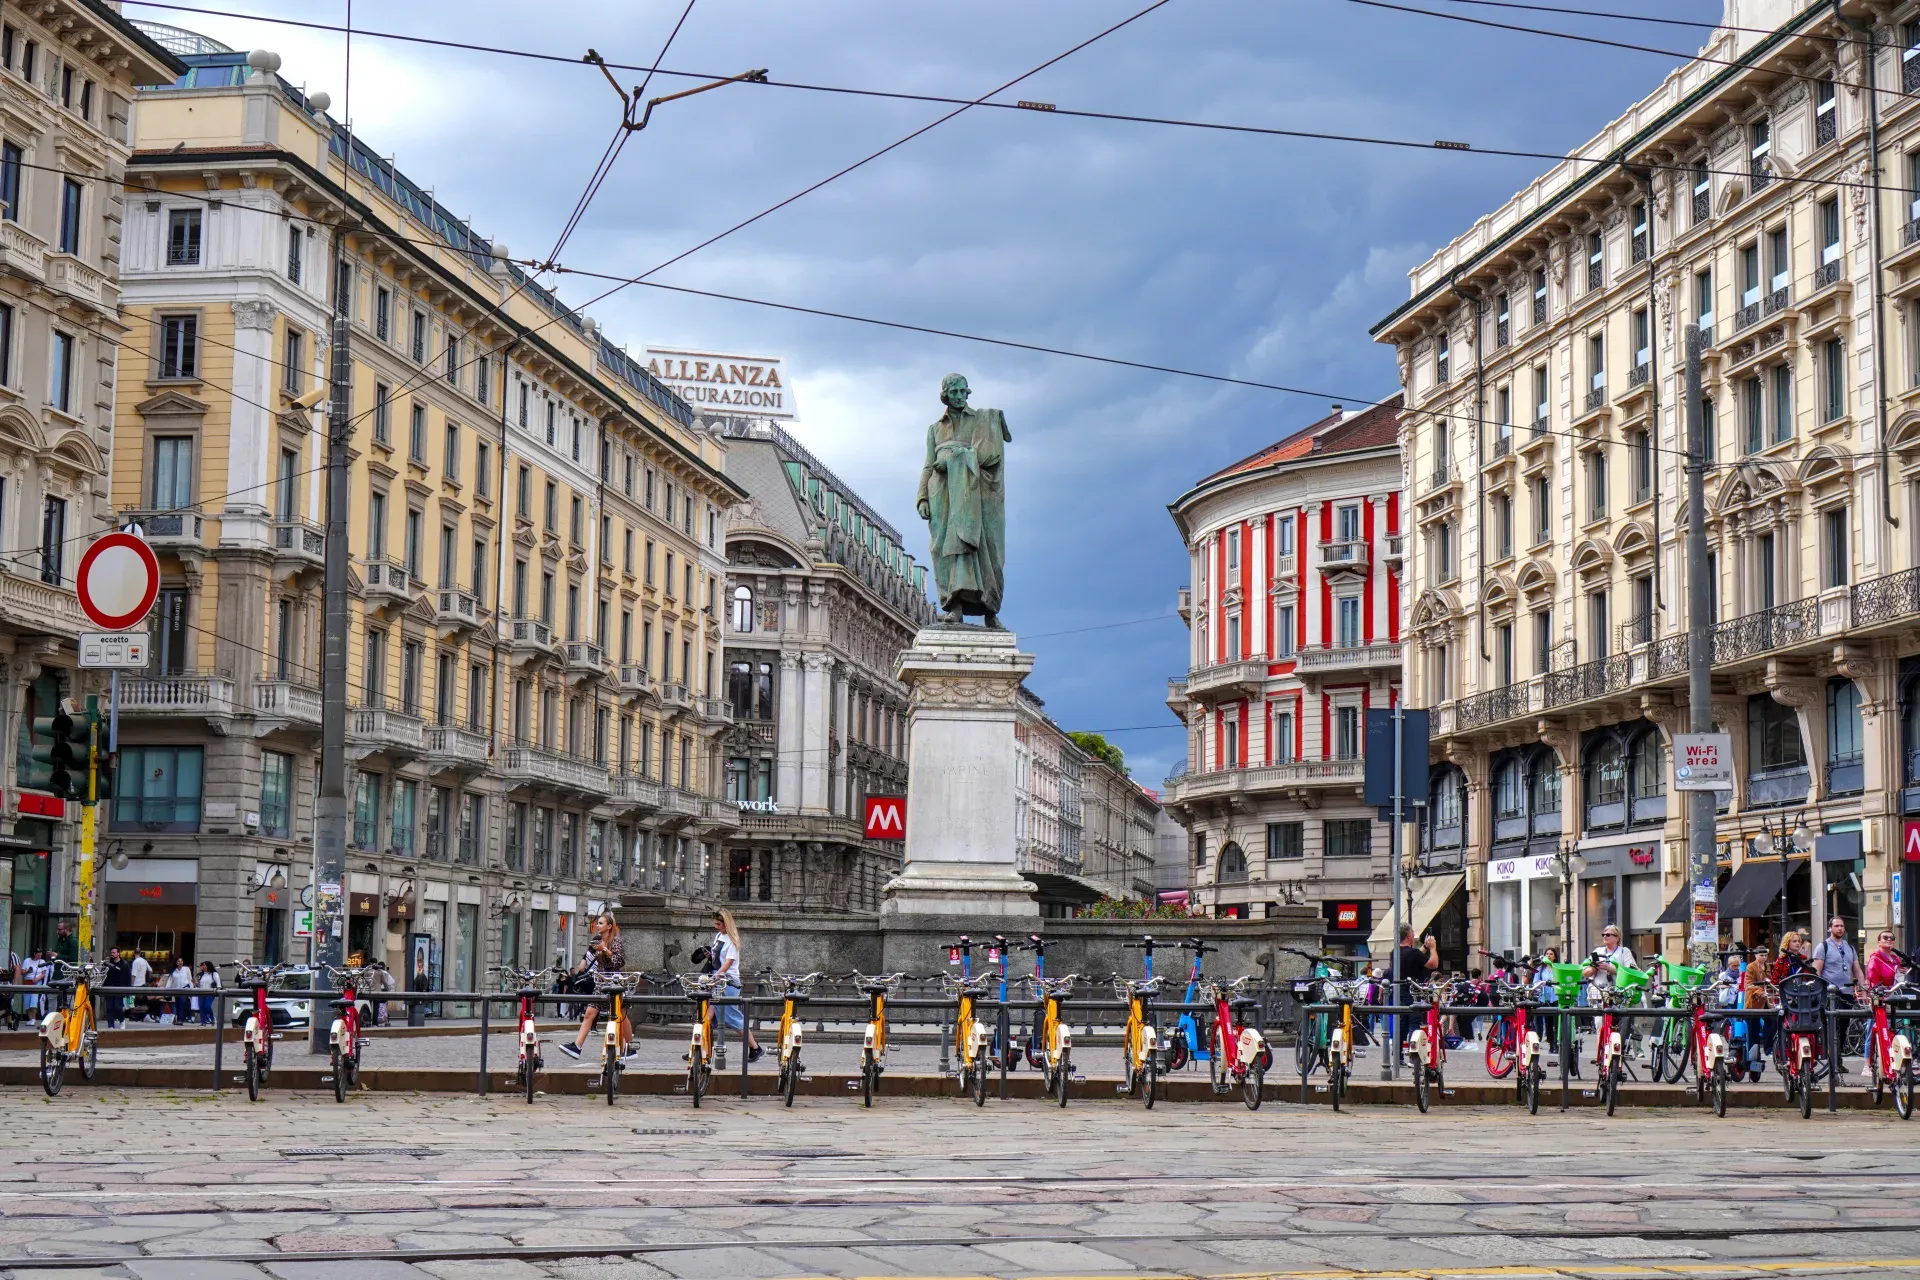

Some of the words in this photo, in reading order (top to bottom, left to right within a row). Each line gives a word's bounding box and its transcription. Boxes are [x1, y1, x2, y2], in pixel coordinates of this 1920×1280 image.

[648, 357, 782, 387] ALLEANZA
[662, 384, 782, 408] ICURAZIONI
[1686, 745, 1718, 756] Wi-Fi
[1686, 757, 1718, 765] area
[867, 804, 903, 830] M
[1496, 861, 1515, 875] KIKO
[1338, 911, 1357, 921] LEGO
[347, 956, 362, 965] ashi
